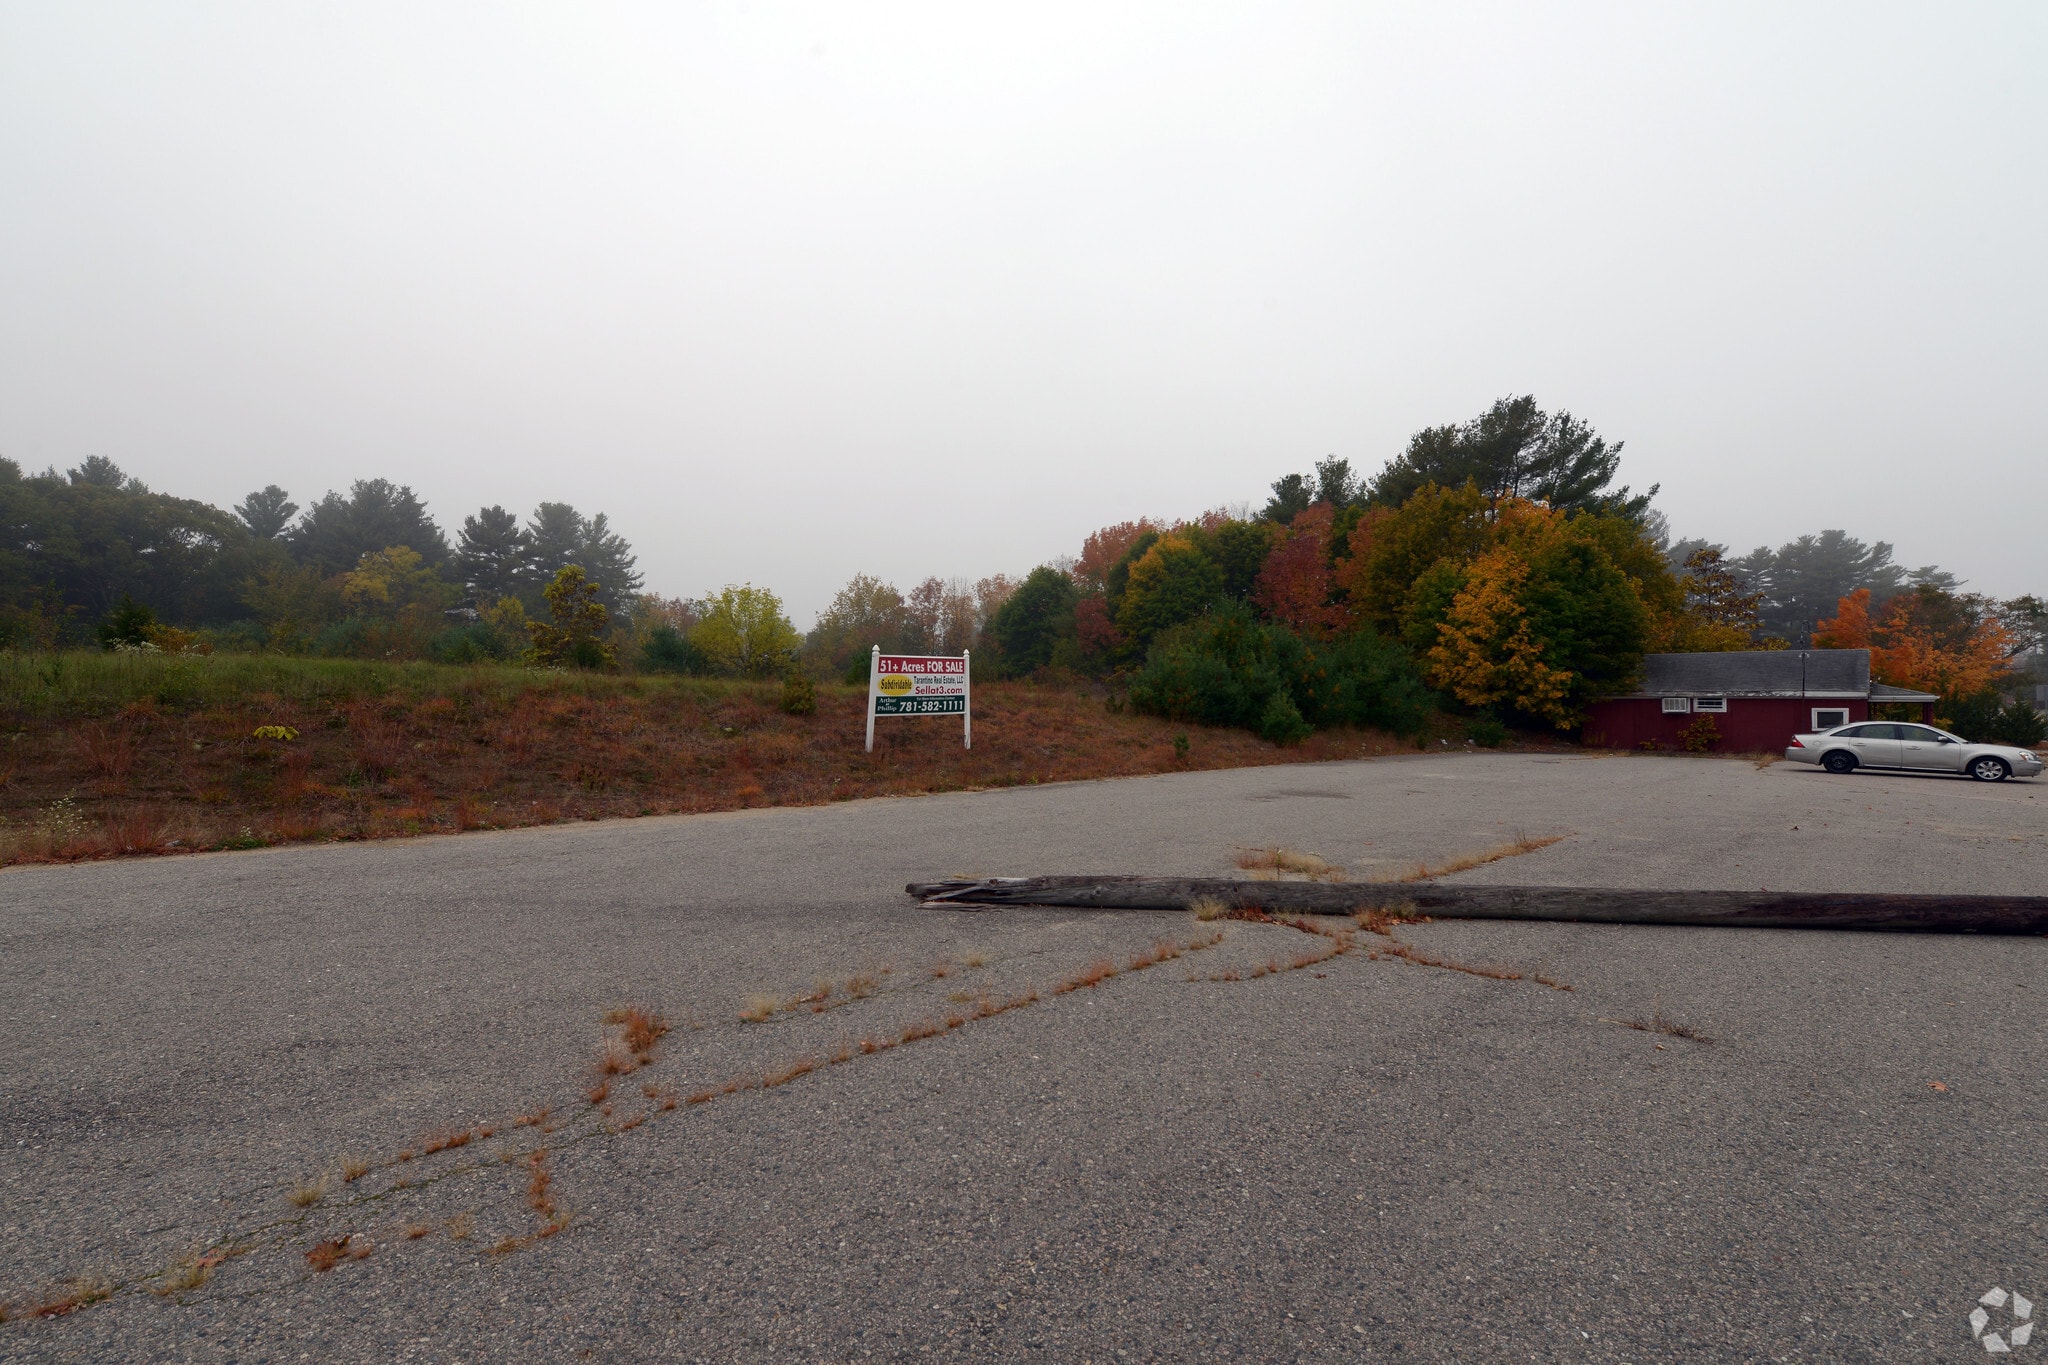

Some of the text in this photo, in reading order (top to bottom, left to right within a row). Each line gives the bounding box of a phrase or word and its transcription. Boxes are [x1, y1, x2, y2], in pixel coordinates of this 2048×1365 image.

[880, 660, 963, 672] 51+ Acres FOR SALE
[880, 679, 912, 690] Subdividable
[915, 685, 963, 695] Sellat3.com
[899, 700, 963, 712] 781-582-1111
